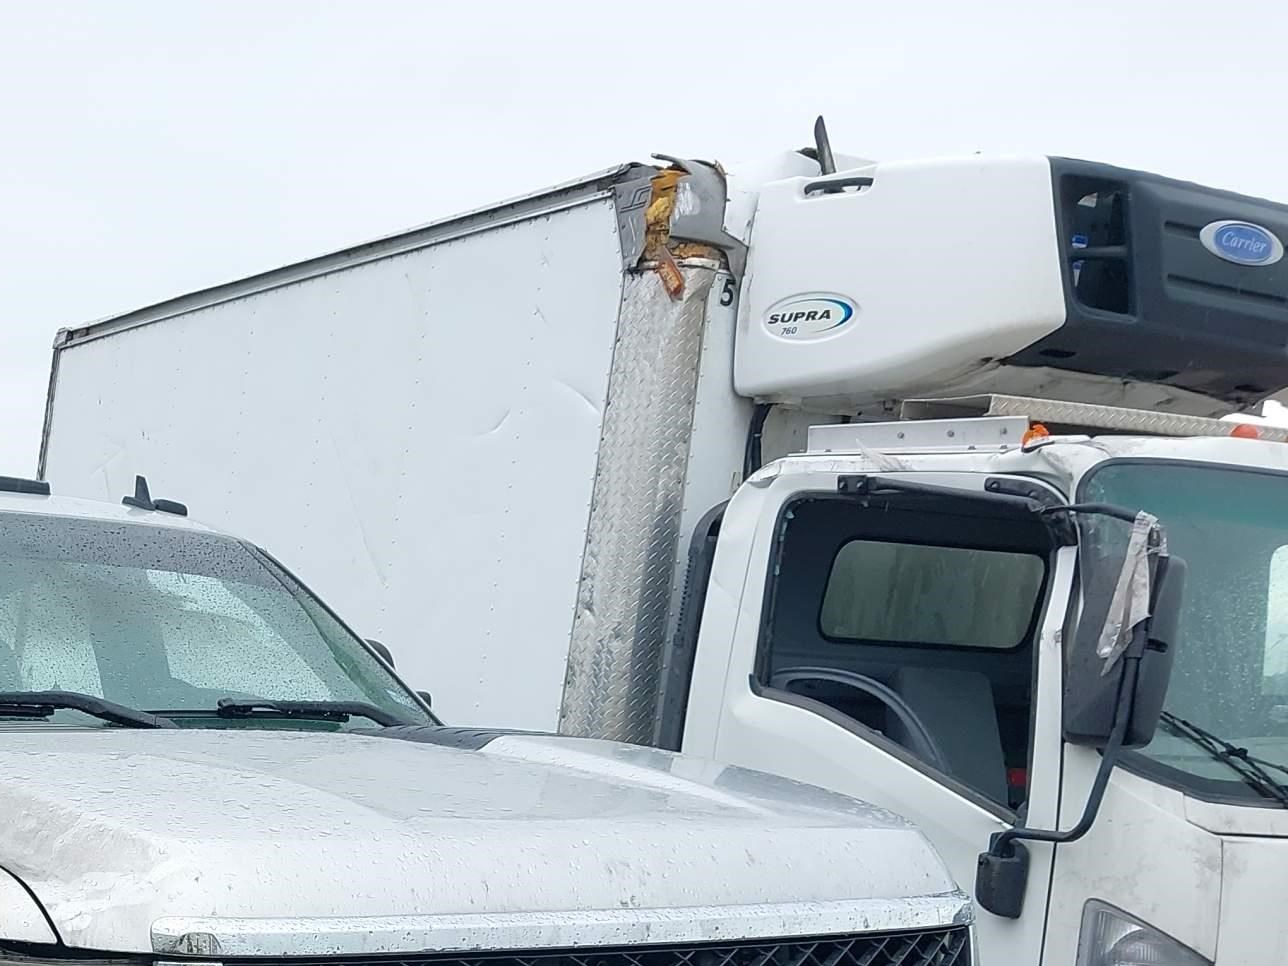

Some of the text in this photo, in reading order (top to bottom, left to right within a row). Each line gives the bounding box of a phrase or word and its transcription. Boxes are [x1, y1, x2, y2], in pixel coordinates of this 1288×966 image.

[1222, 231, 1267, 253] Carrier
[719, 278, 736, 307] 5
[767, 309, 831, 325] SUPRA
[780, 326, 798, 336] 760
